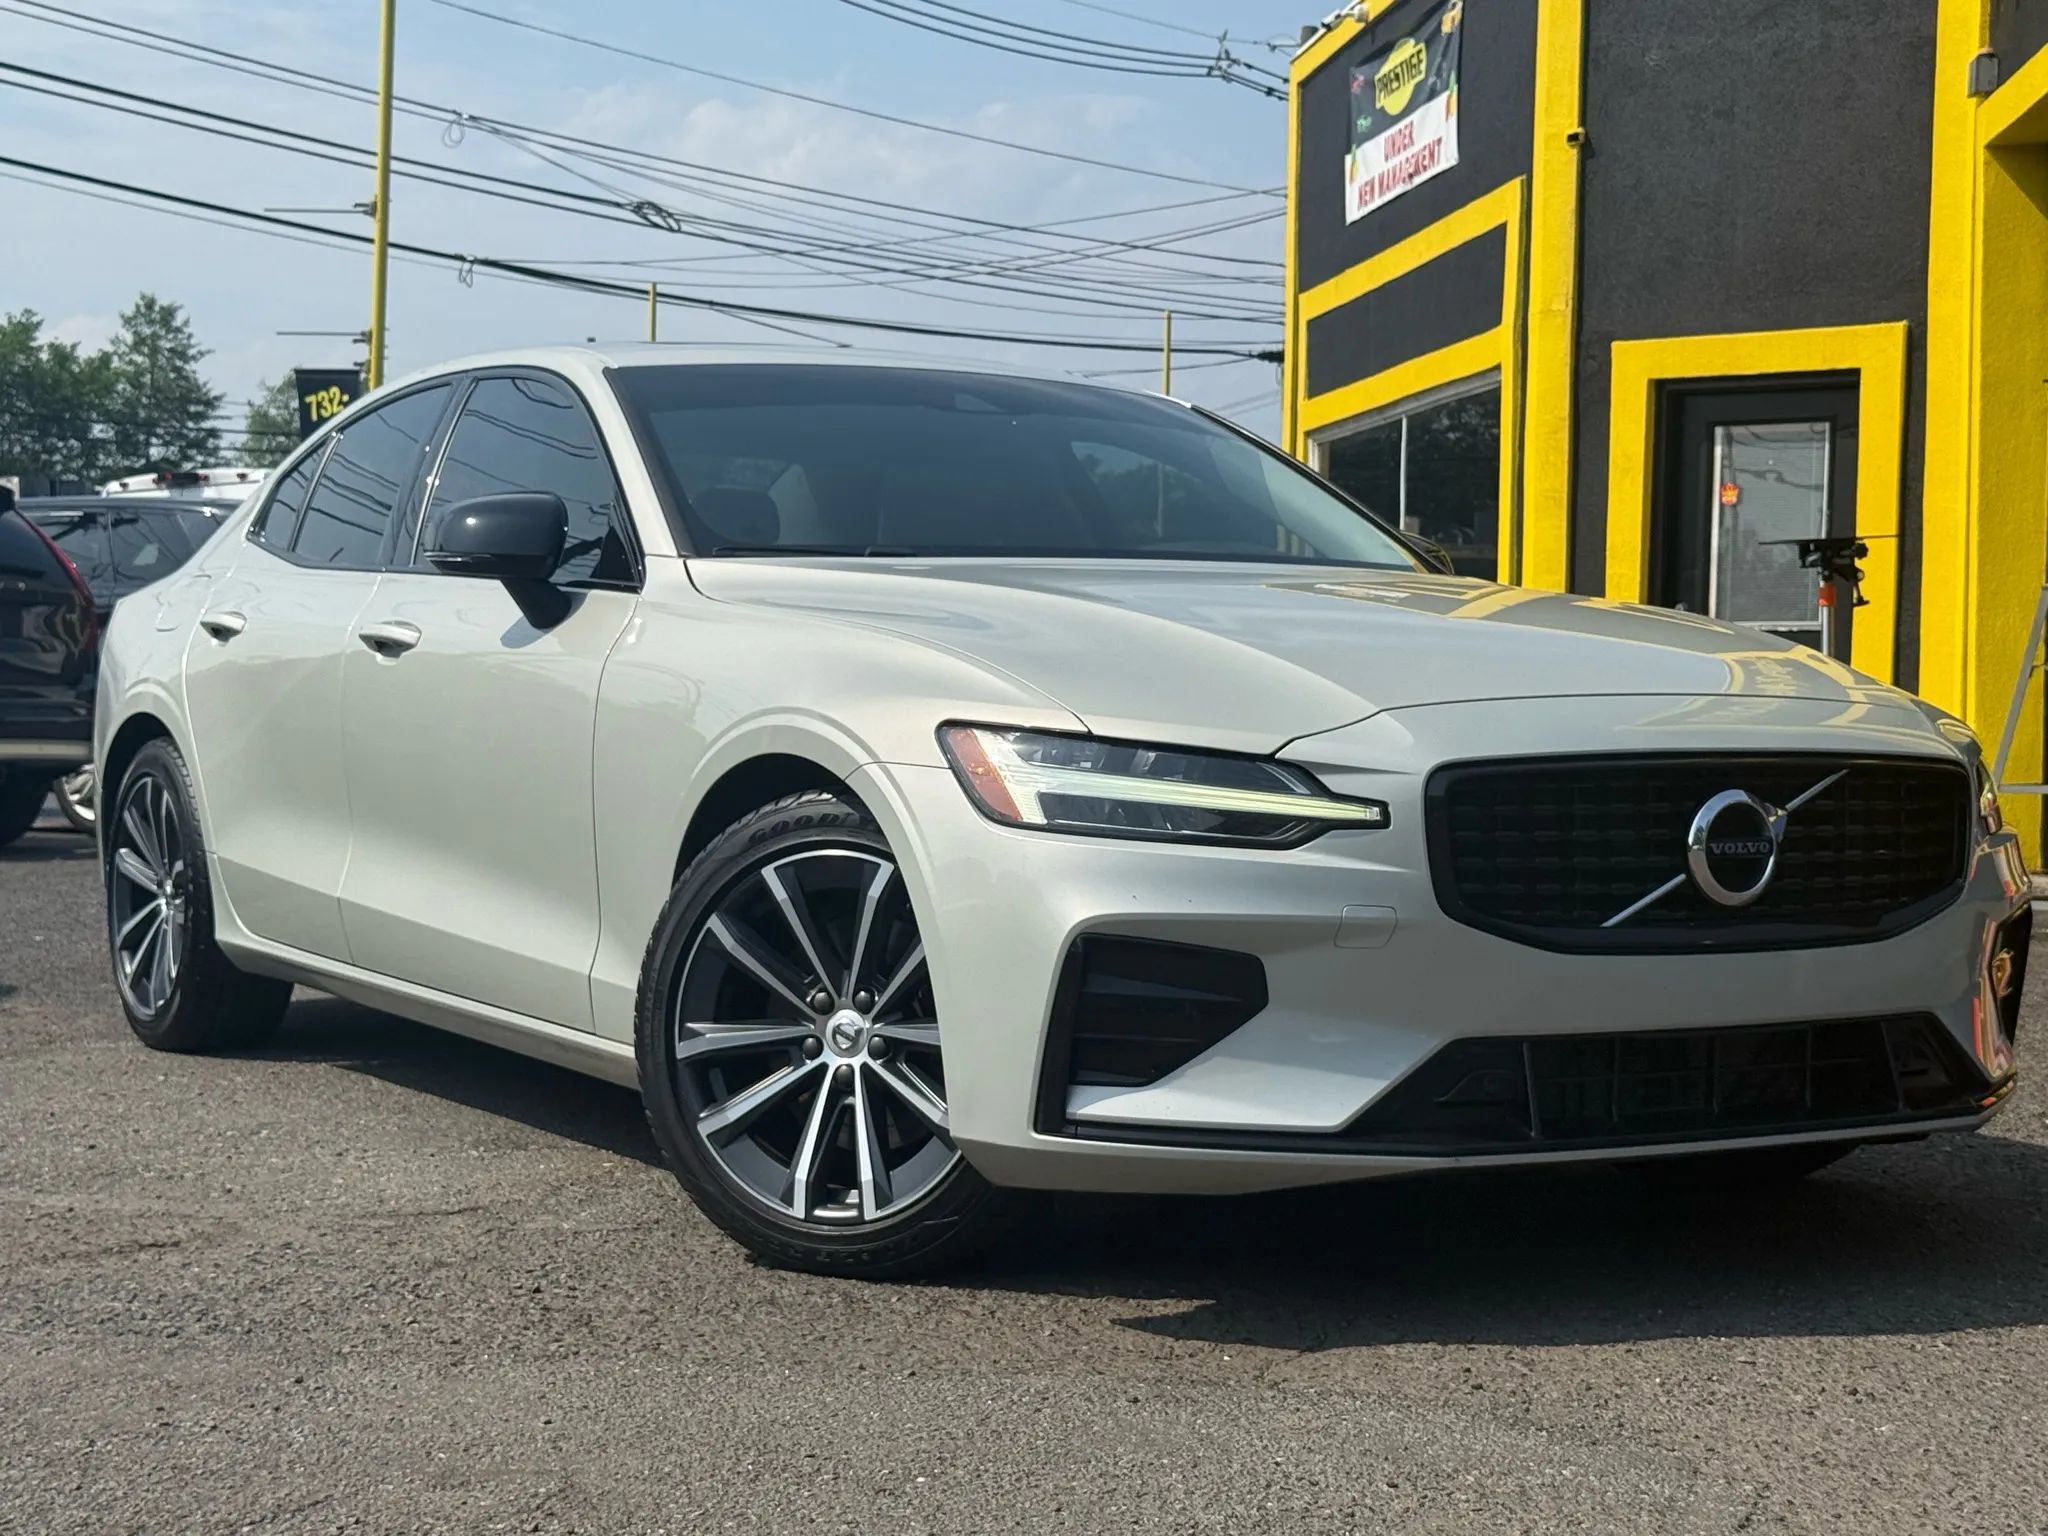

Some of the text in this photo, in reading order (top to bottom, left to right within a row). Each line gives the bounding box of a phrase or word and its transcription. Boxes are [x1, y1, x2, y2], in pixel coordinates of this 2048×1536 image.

[1377, 48, 1424, 101] PRESTIGE
[1383, 120, 1415, 162] UNDER
[1357, 137, 1442, 211] NEW MANAGEMENT
[1711, 842, 1770, 854] VOLVO
